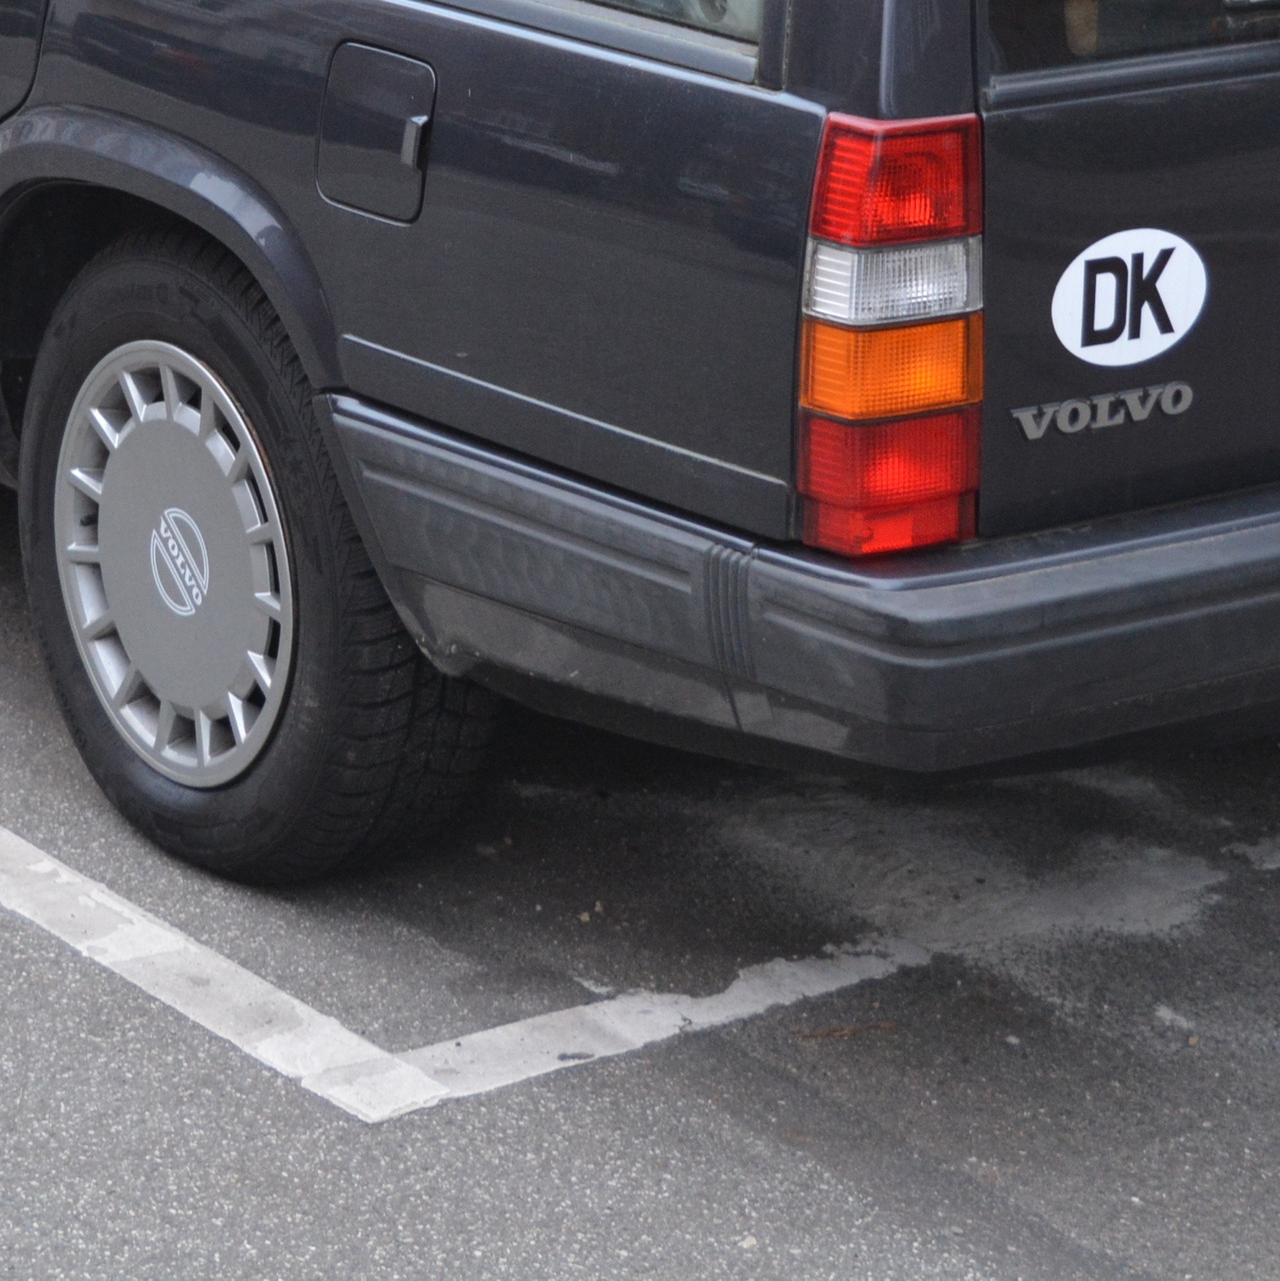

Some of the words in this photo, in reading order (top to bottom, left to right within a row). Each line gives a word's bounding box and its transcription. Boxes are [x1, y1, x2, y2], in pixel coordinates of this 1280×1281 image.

[1080, 246, 1177, 349] DK
[1010, 380, 1194, 441] VOLVO
[159, 515, 203, 607] VOLVO
